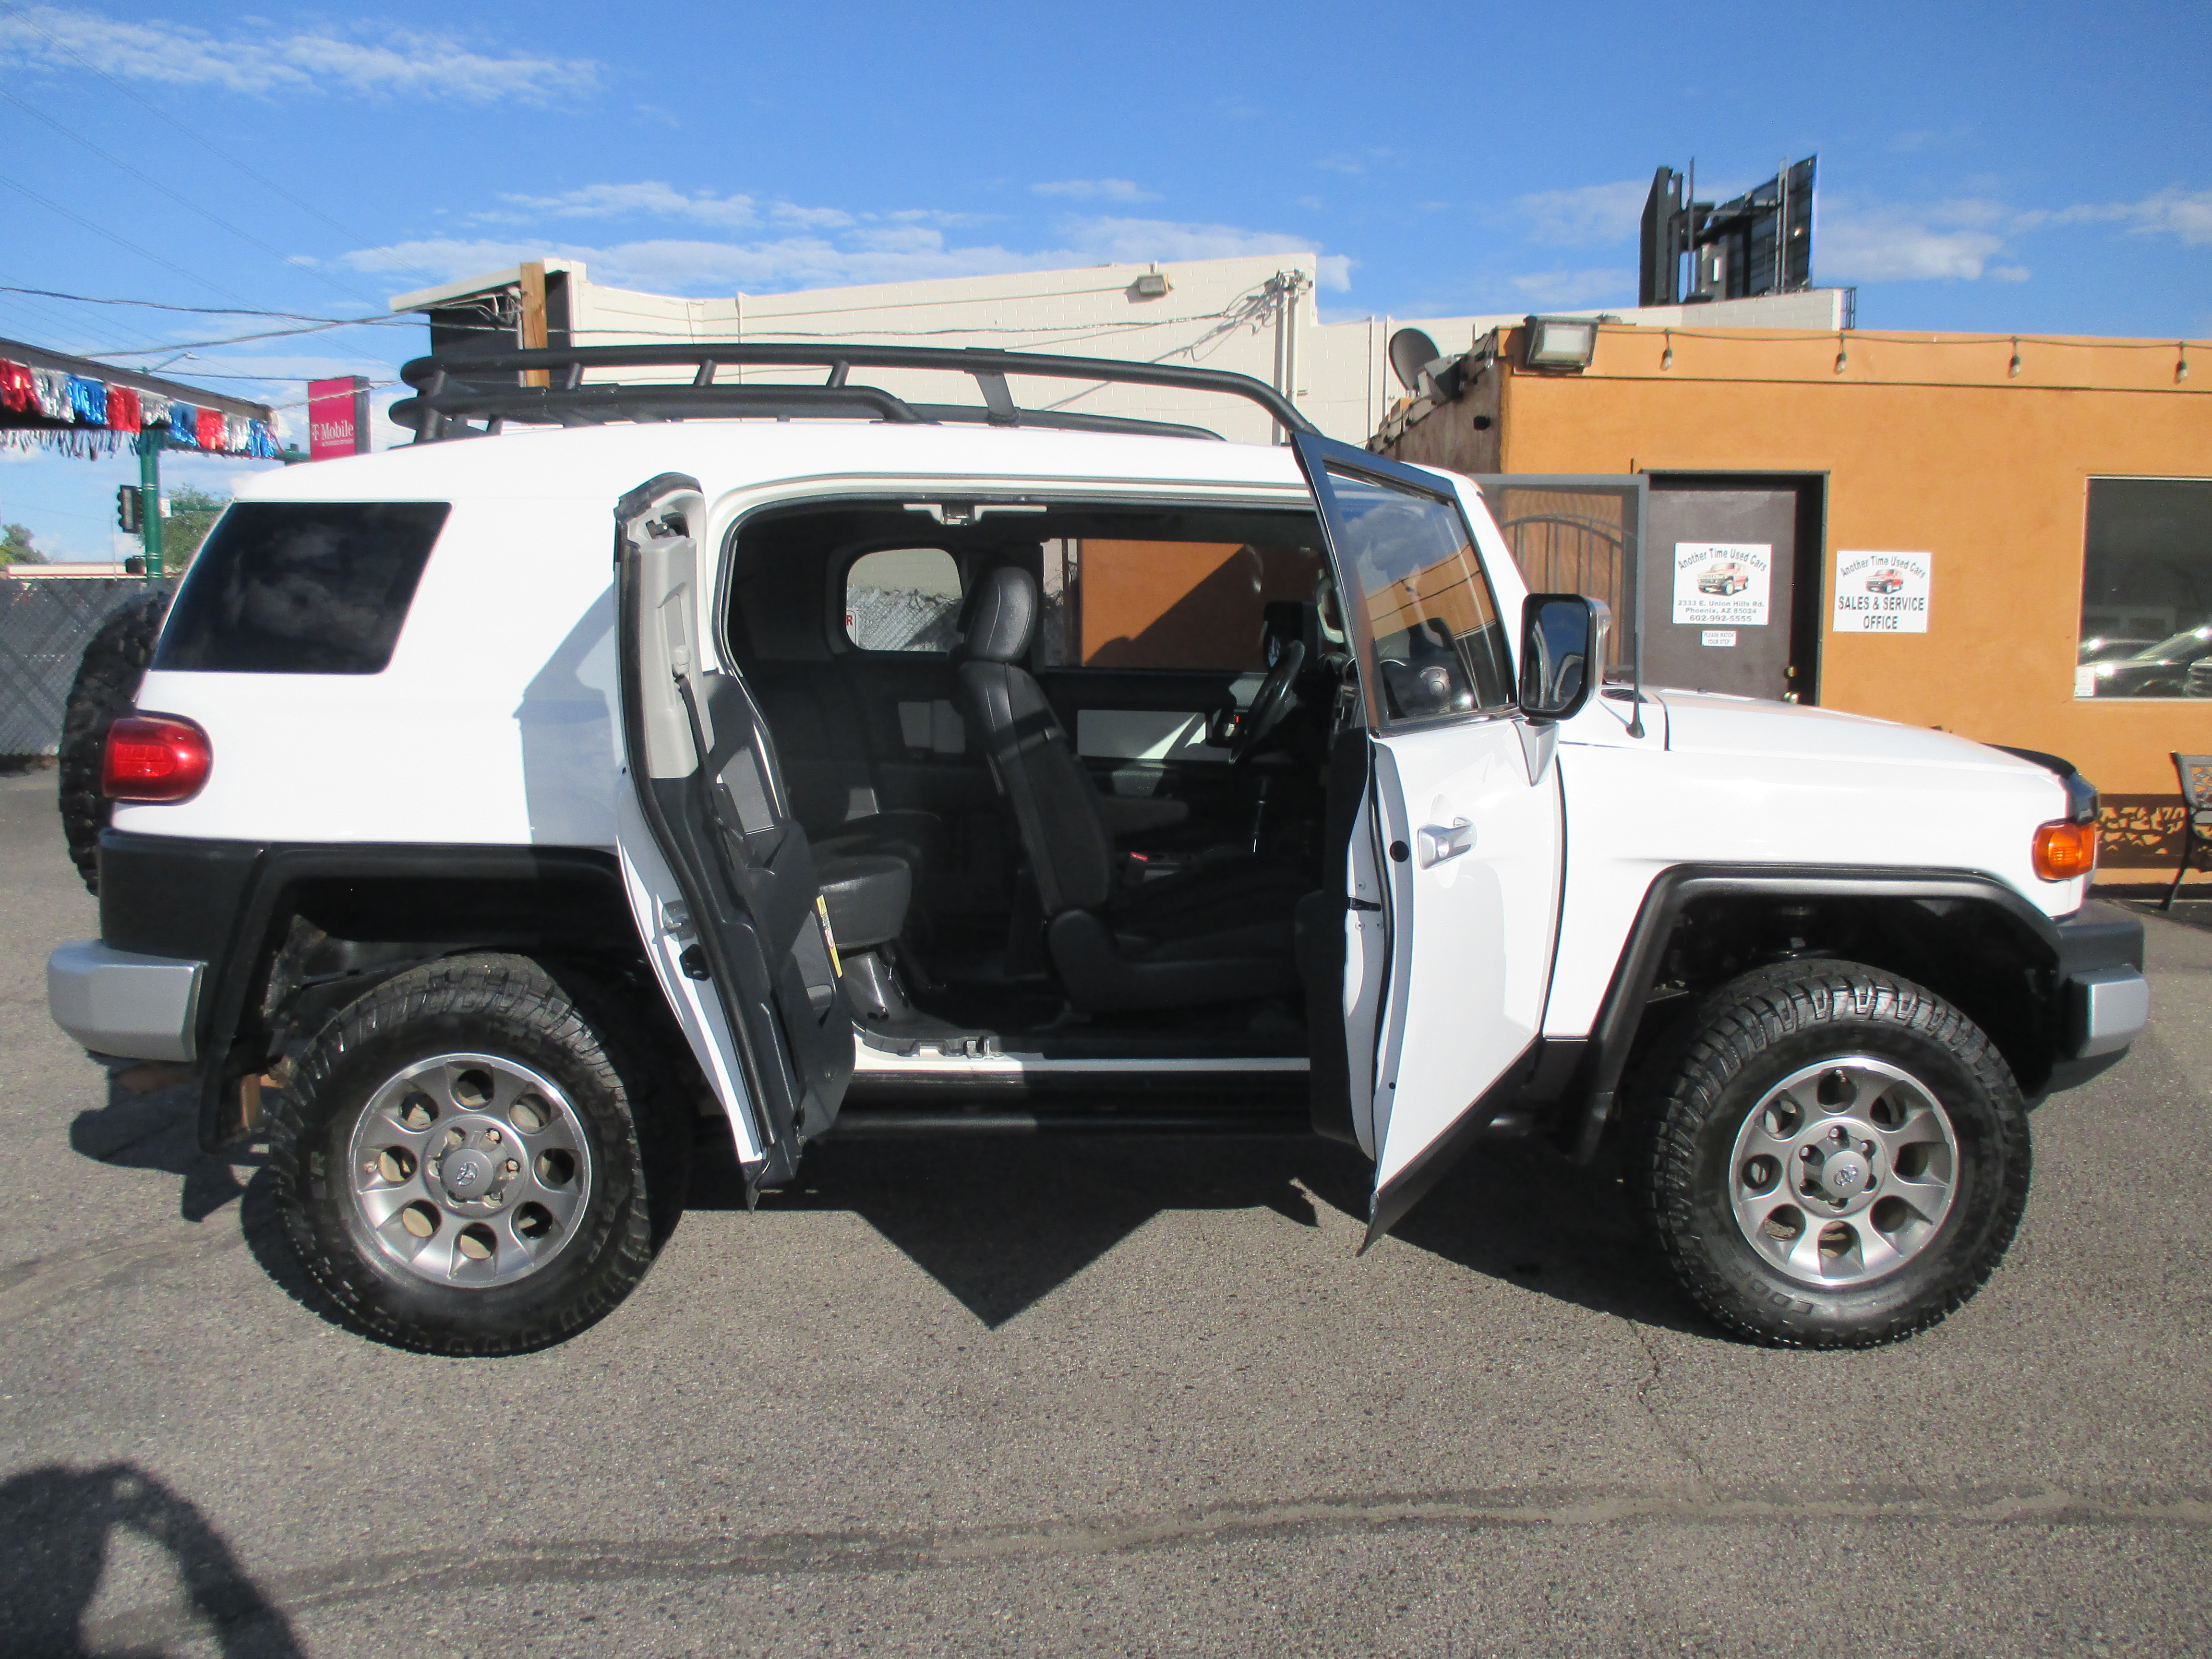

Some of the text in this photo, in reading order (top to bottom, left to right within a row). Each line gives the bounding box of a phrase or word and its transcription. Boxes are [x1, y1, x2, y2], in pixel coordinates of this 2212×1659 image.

[1677, 548, 1767, 572] Another Time Used Cars
[1840, 555, 1926, 579] Another Time Used Cars
[1838, 596, 1925, 611] SALES & SERVICE
[1863, 615, 1899, 630] OFFICE
